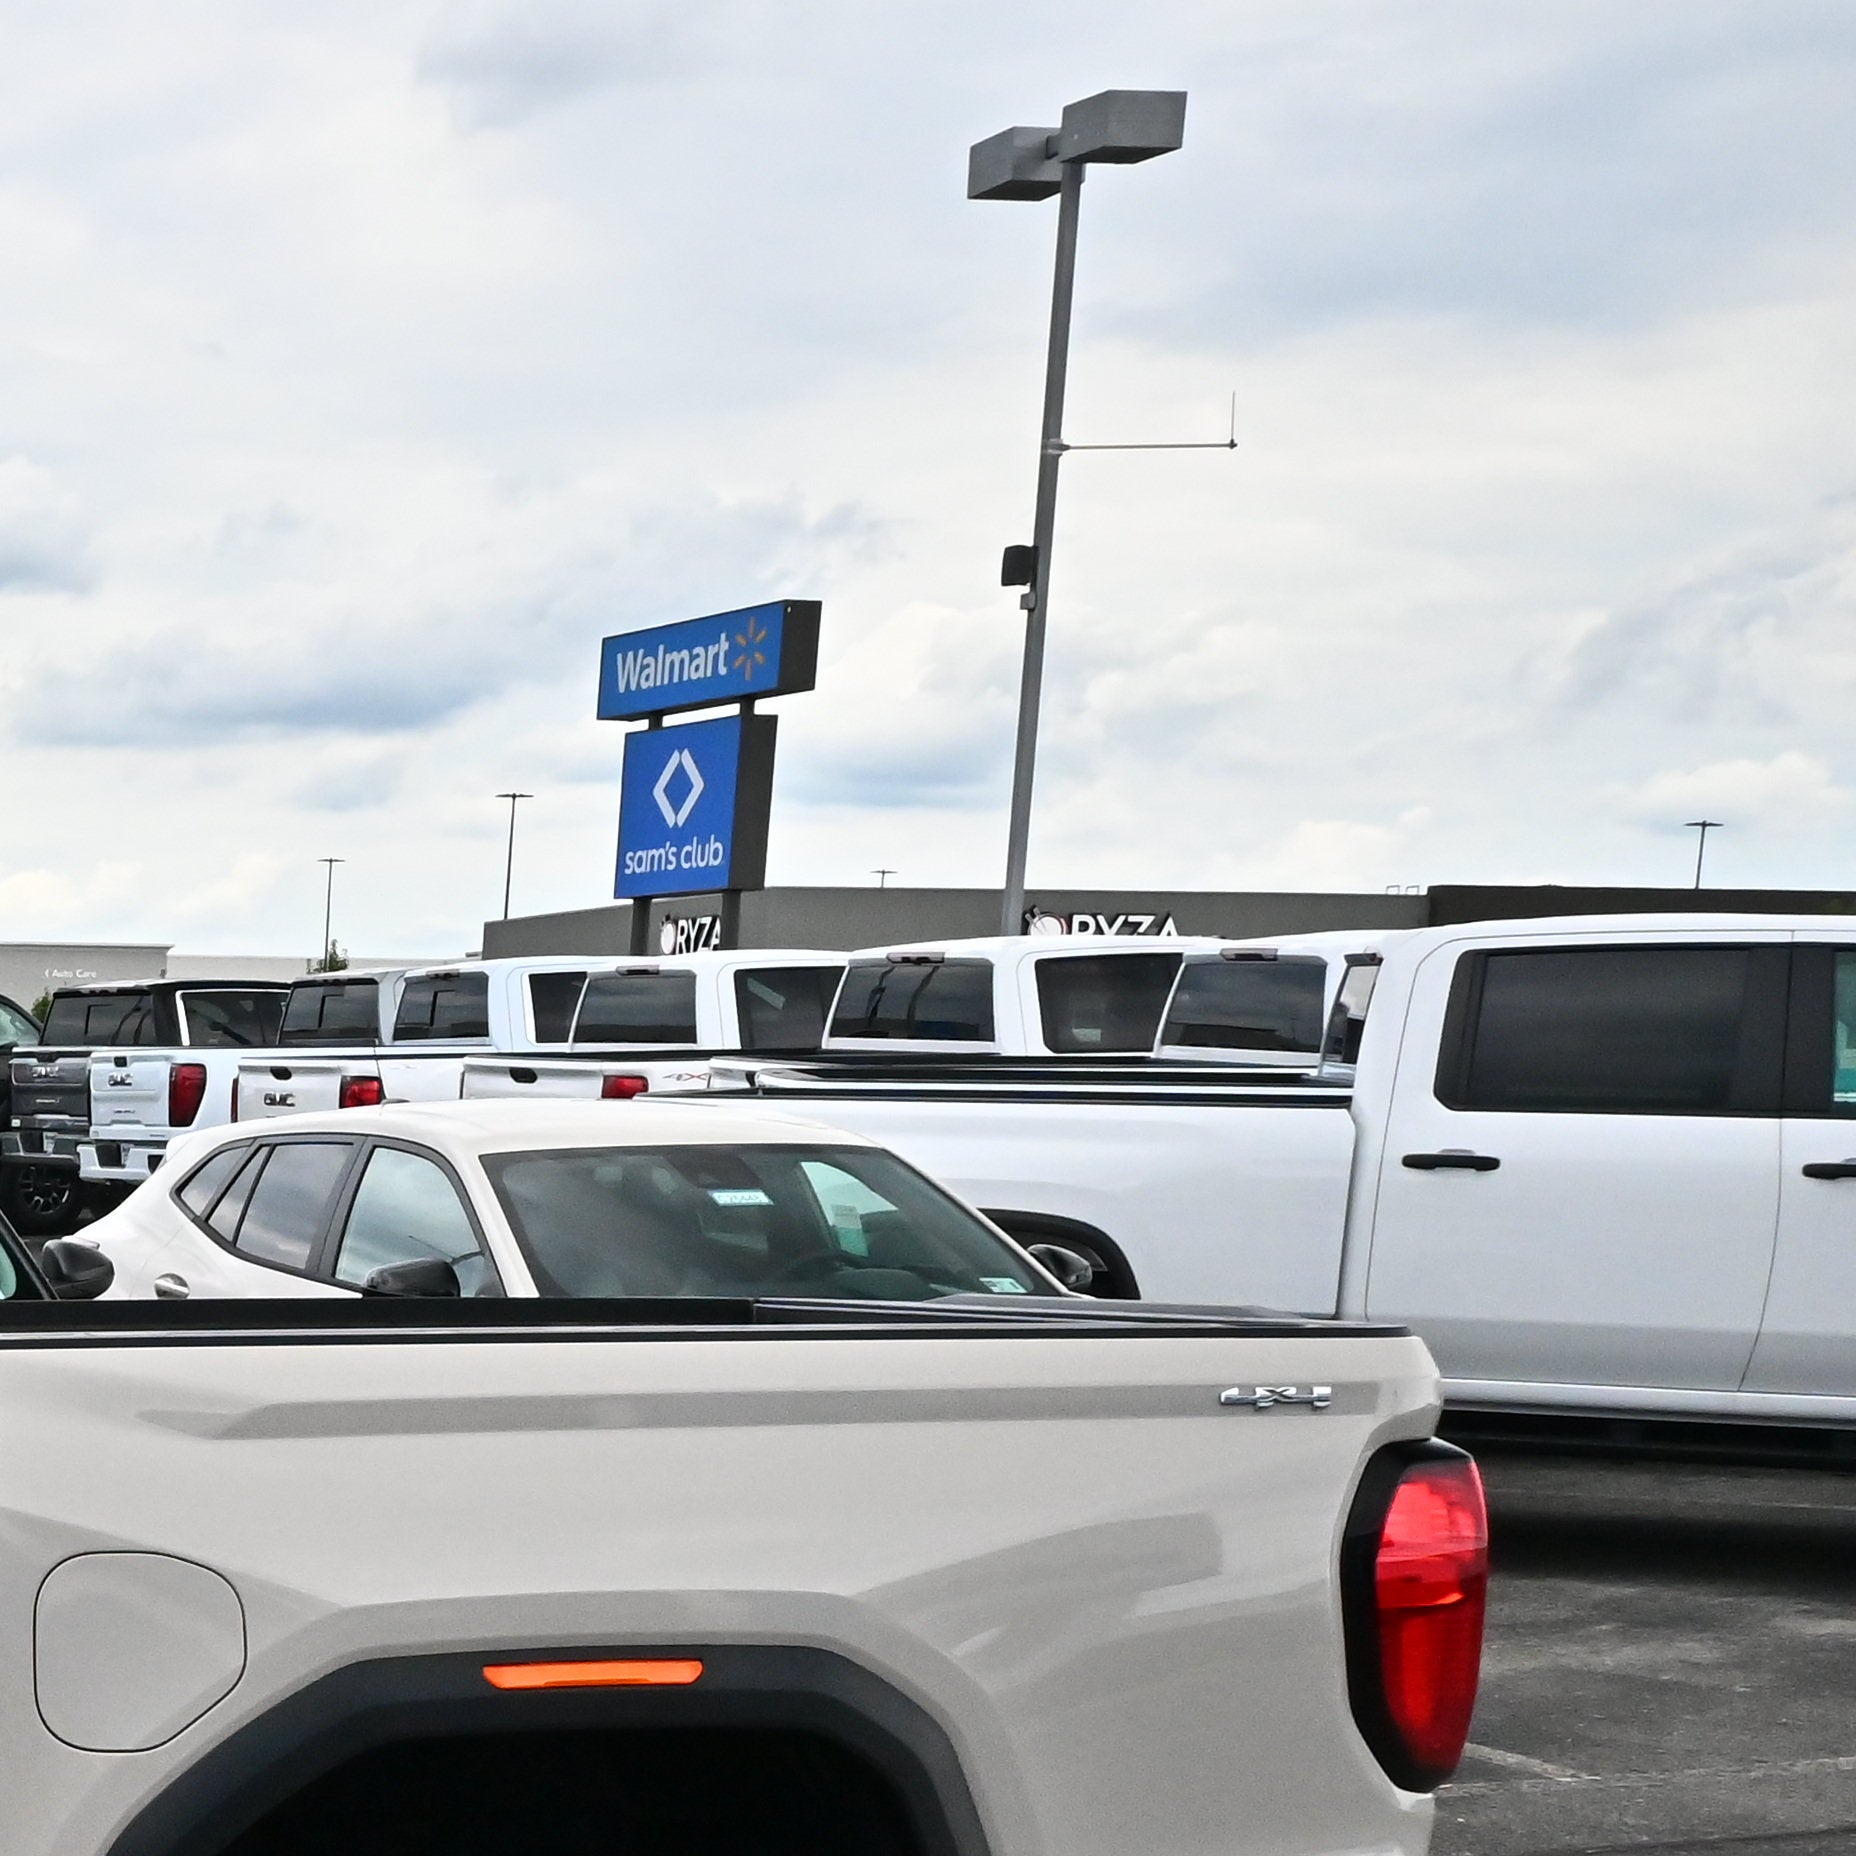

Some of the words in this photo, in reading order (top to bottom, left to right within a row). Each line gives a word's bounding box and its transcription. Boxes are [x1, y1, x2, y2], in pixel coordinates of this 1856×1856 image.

[616, 632, 729, 693] Walmart
[624, 841, 676, 874] sam's
[680, 834, 724, 868] club
[51, 969, 73, 978] Auto
[76, 969, 97, 978] Care
